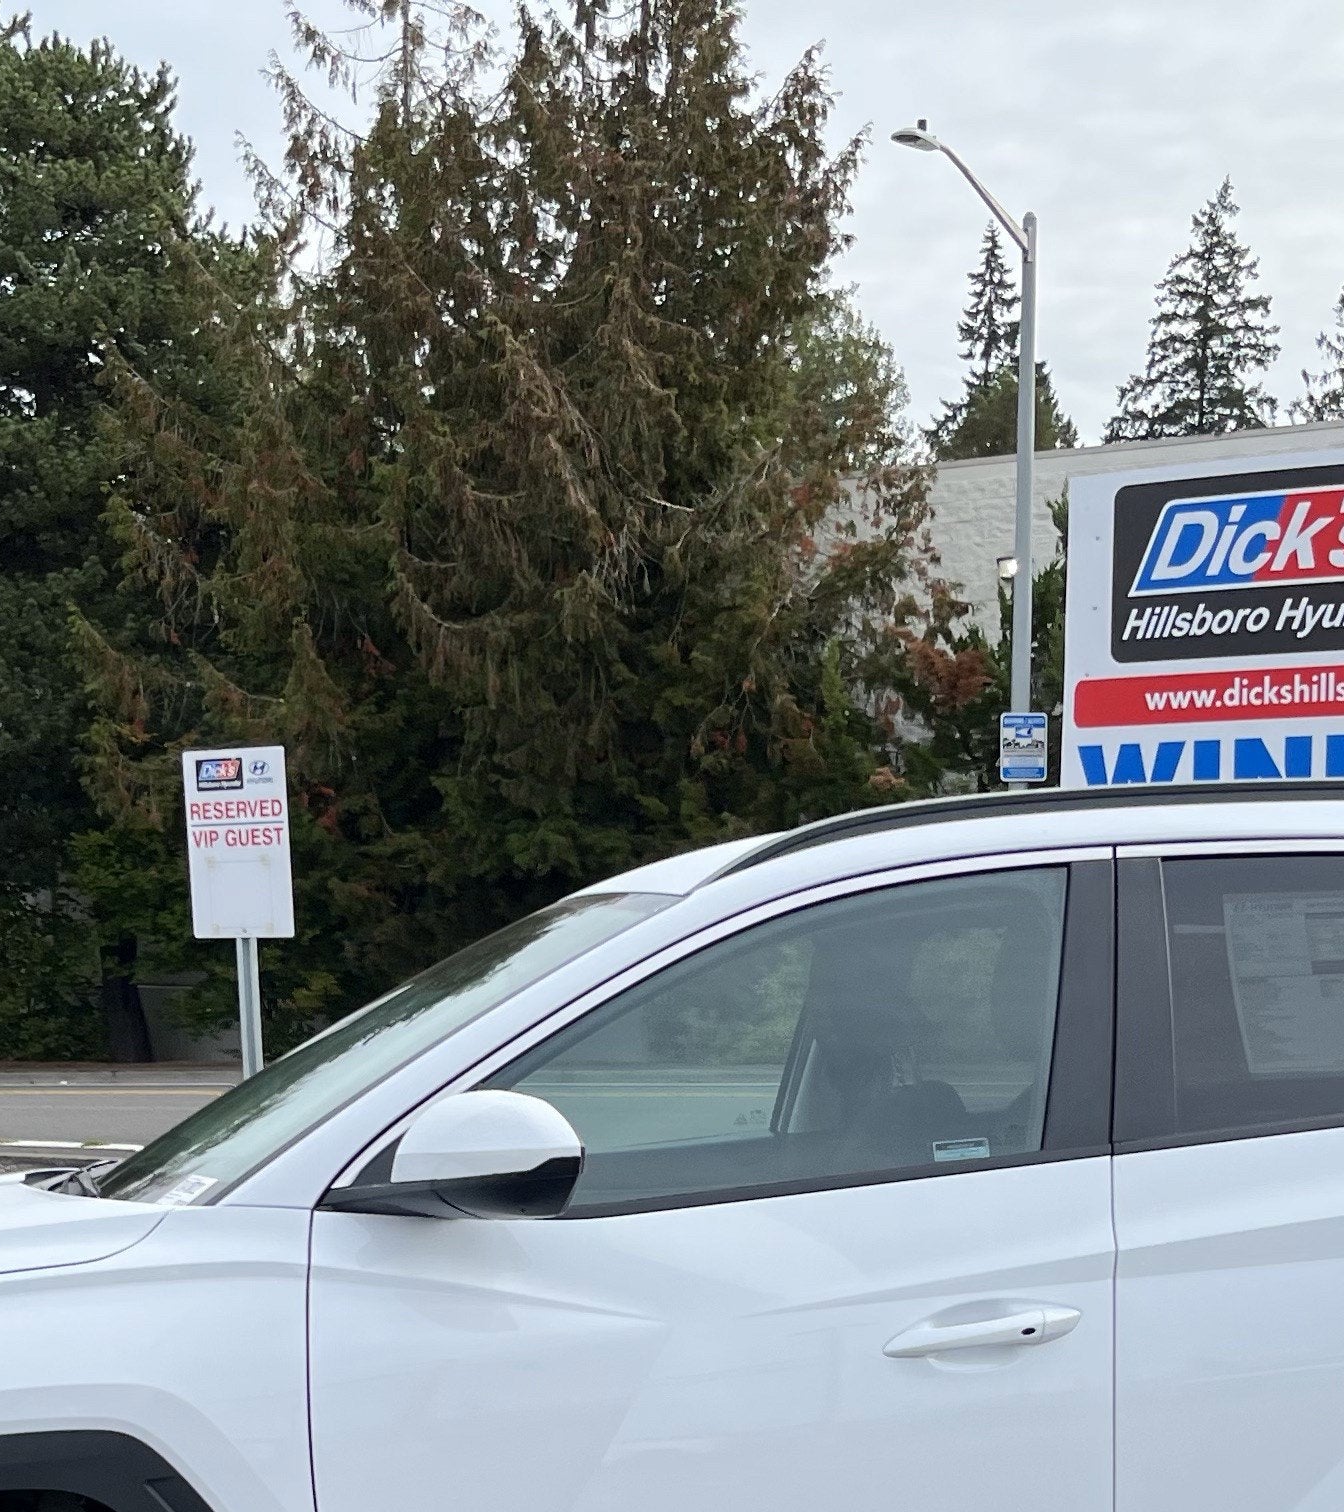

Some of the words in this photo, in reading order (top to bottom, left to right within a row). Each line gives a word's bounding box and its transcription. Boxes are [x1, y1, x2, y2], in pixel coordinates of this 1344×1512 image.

[1121, 602, 1272, 641] Hillsboro
[190, 799, 283, 821] RESERVED
[192, 829, 219, 849] VIP
[225, 827, 284, 848] GUEST
